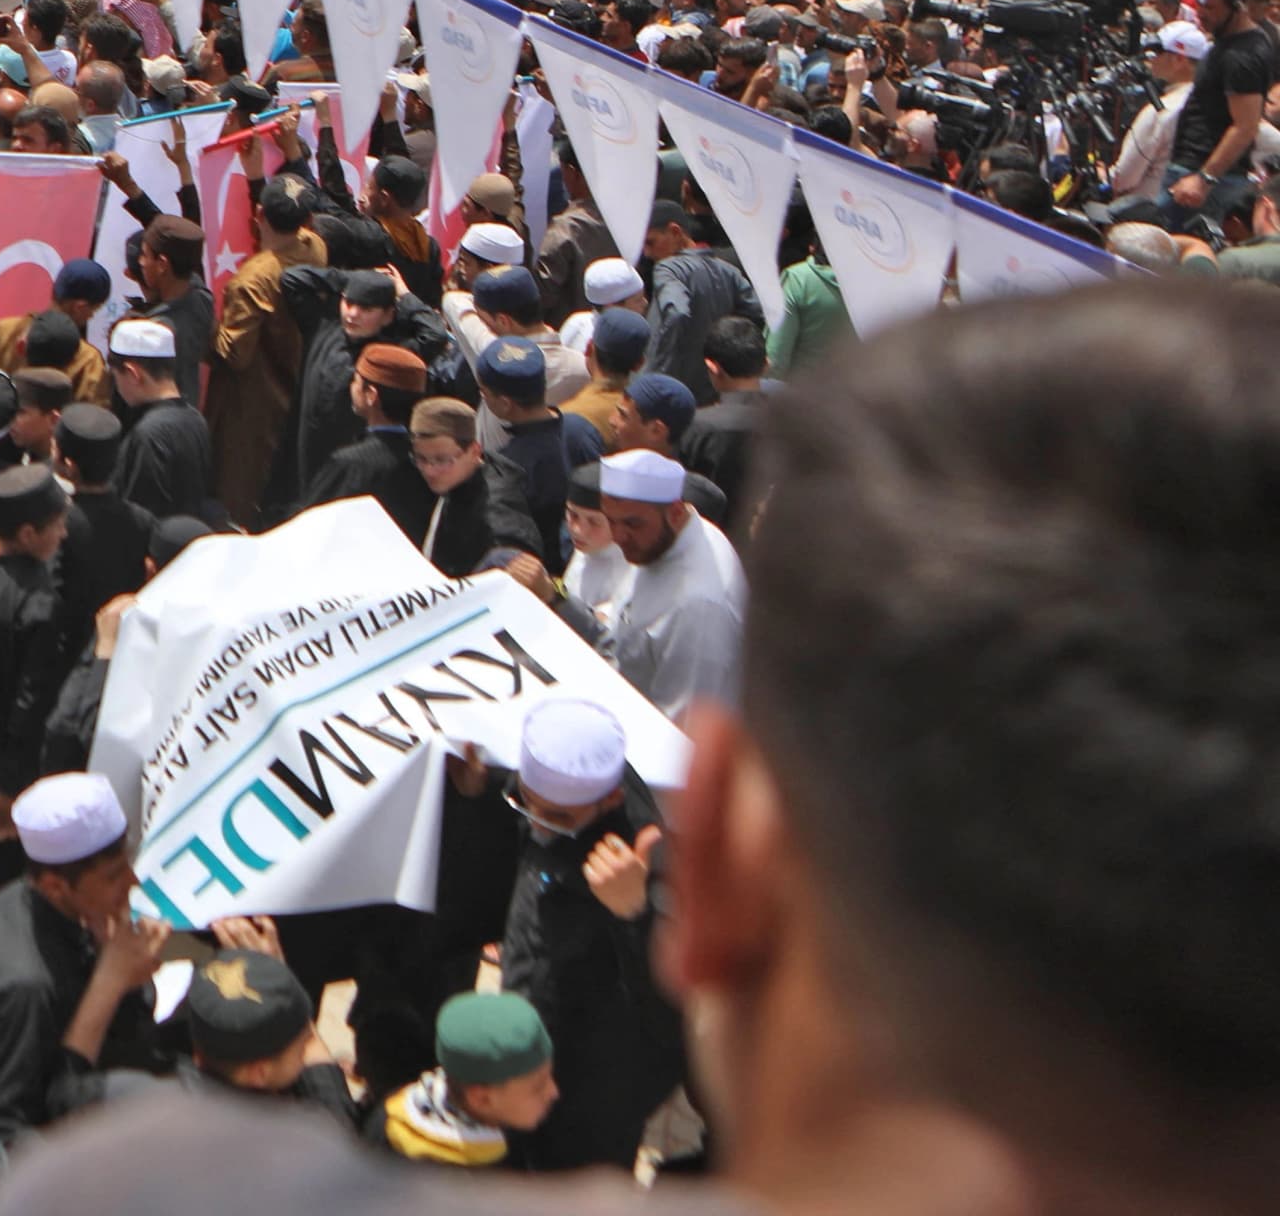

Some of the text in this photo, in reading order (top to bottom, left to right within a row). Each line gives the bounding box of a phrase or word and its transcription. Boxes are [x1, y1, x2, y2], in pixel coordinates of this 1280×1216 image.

[280, 606, 317, 634] VE
[252, 630, 336, 689] ADAM
[192, 680, 259, 753] SAİT
